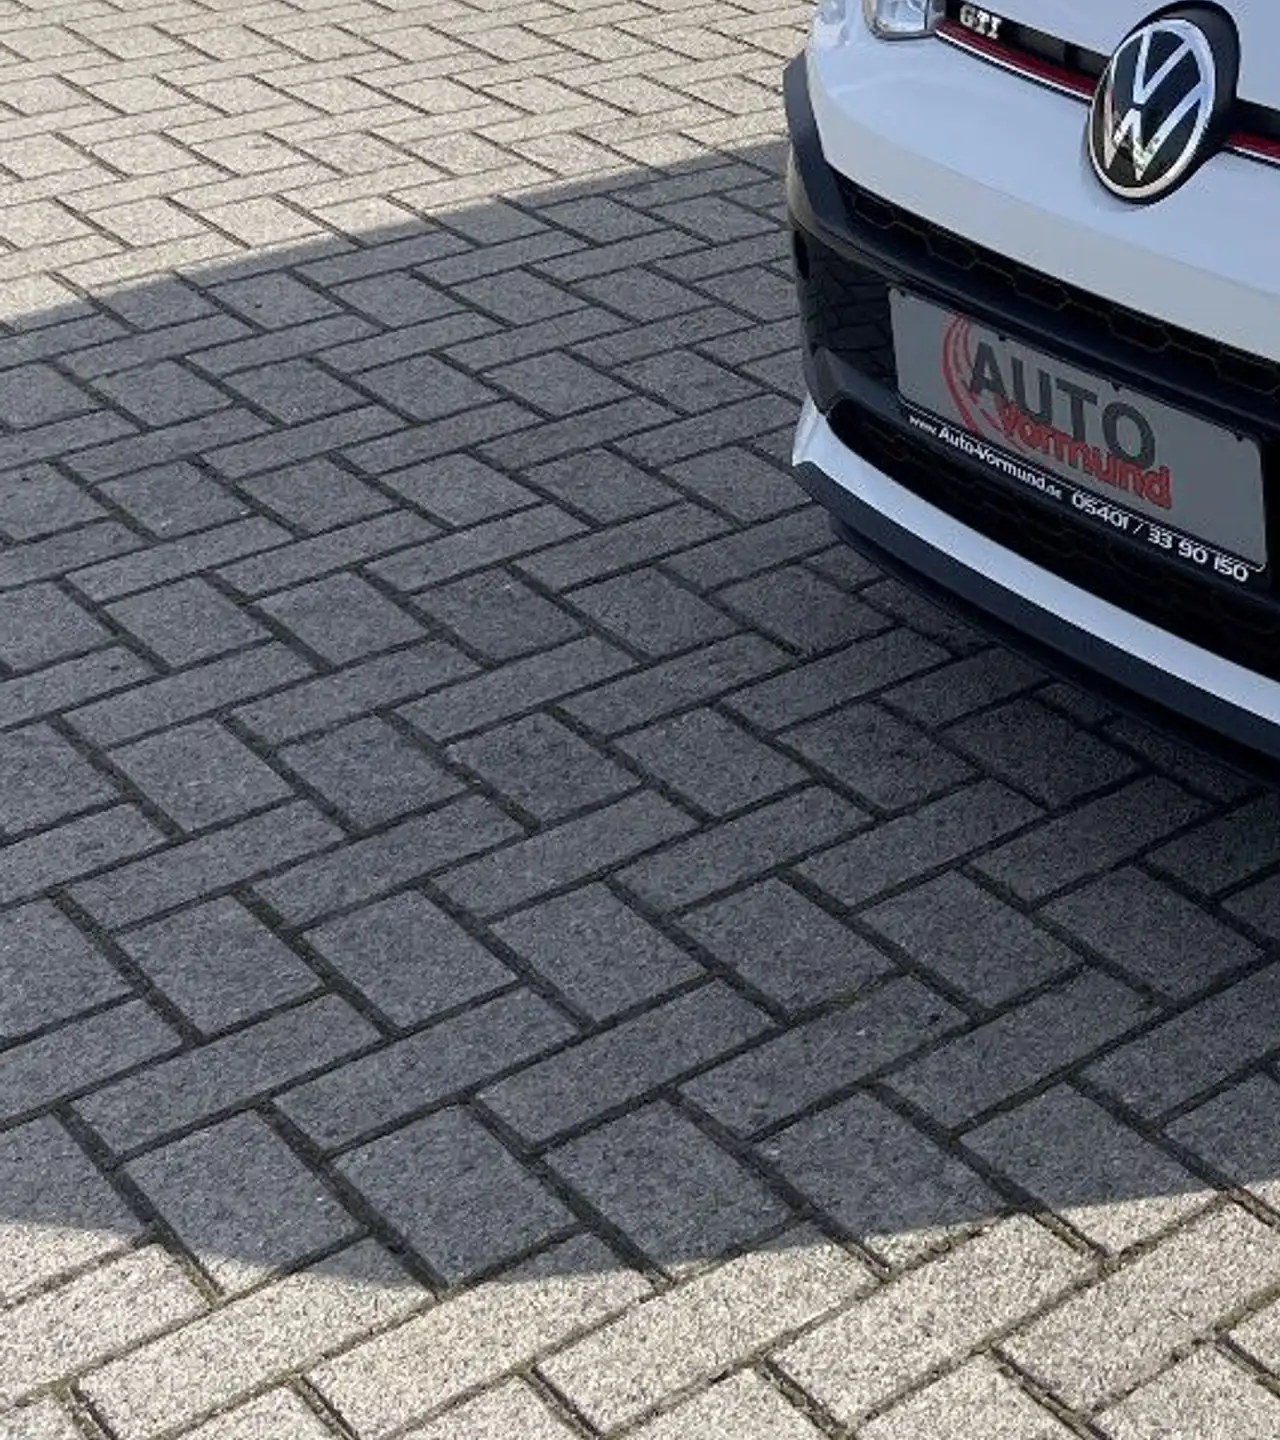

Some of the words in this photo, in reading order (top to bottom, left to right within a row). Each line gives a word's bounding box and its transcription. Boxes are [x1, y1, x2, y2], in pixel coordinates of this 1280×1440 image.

[960, 4, 1002, 40] GTI
[969, 341, 1156, 469] AUTO
[996, 398, 1172, 510] Vormund
[1071, 490, 1129, 530] 05401
[1147, 524, 1173, 550] 33
[1178, 537, 1208, 564] 90
[1213, 554, 1249, 582] 150
